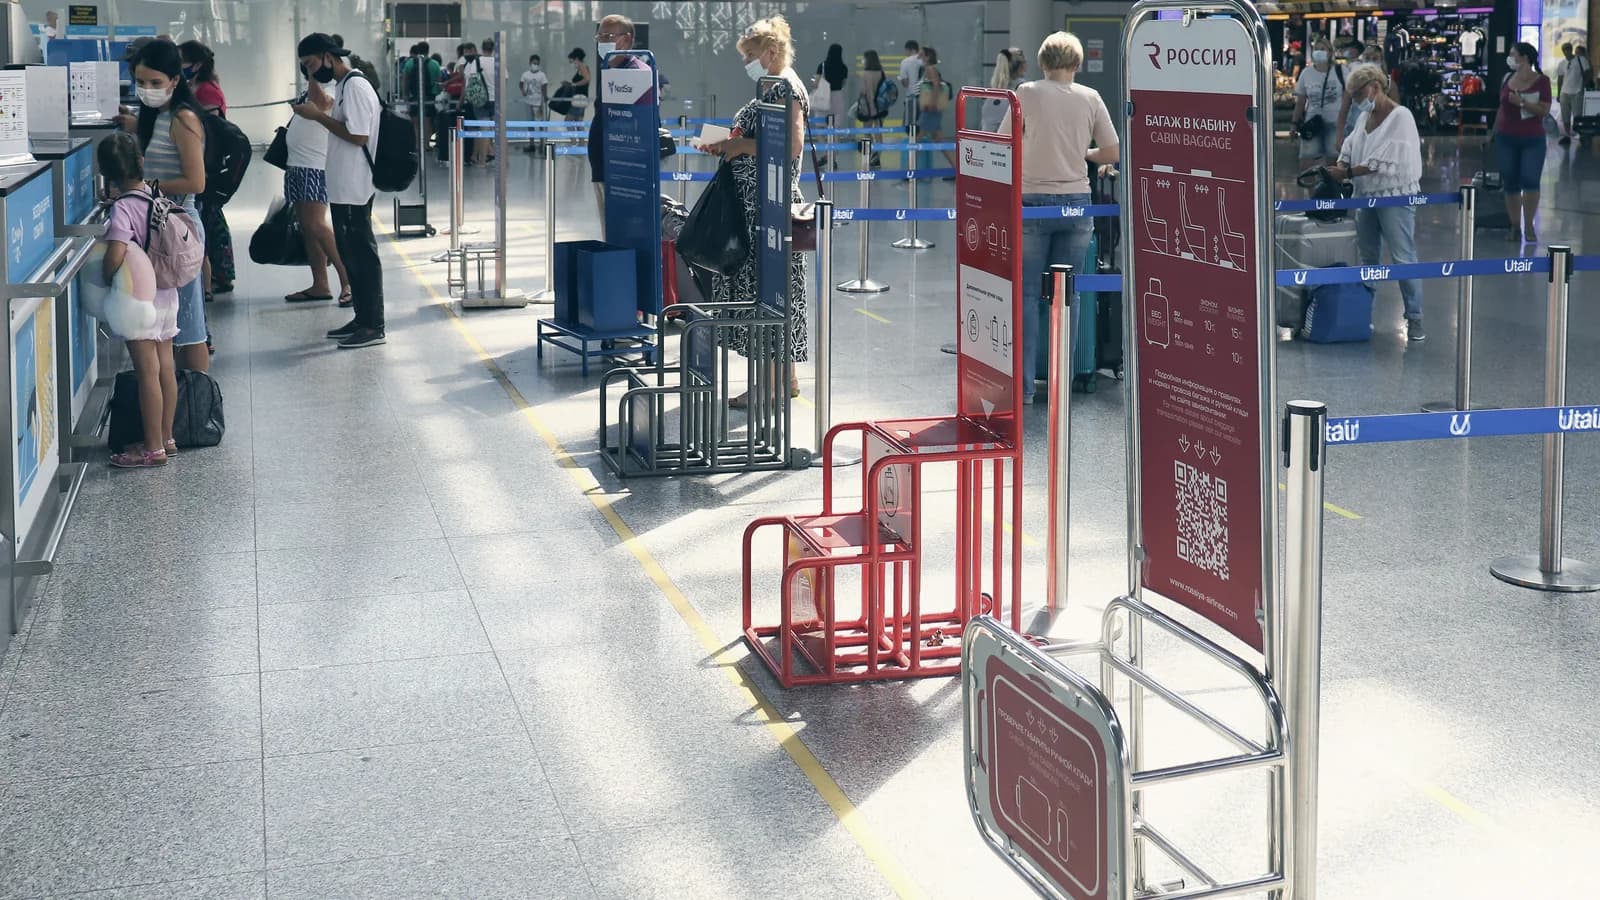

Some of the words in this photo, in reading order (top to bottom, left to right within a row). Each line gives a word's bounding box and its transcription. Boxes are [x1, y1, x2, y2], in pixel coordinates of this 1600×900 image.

[1167, 48, 1236, 65] РОССИЯ
[1145, 115, 1181, 128] БАГАЖ
[1183, 117, 1191, 129] В
[1193, 118, 1236, 132] КАБИНУ
[1150, 131, 1180, 145] CABIN
[1183, 134, 1231, 150] BAGGAGE
[1316, 200, 1336, 209] Utair
[1408, 195, 1428, 205] Utair
[1061, 206, 1084, 217] Utair
[1360, 267, 1391, 280] Utair
[1504, 259, 1533, 272] Utair
[1325, 419, 1359, 442] tair
[1558, 409, 1600, 430] Utai
